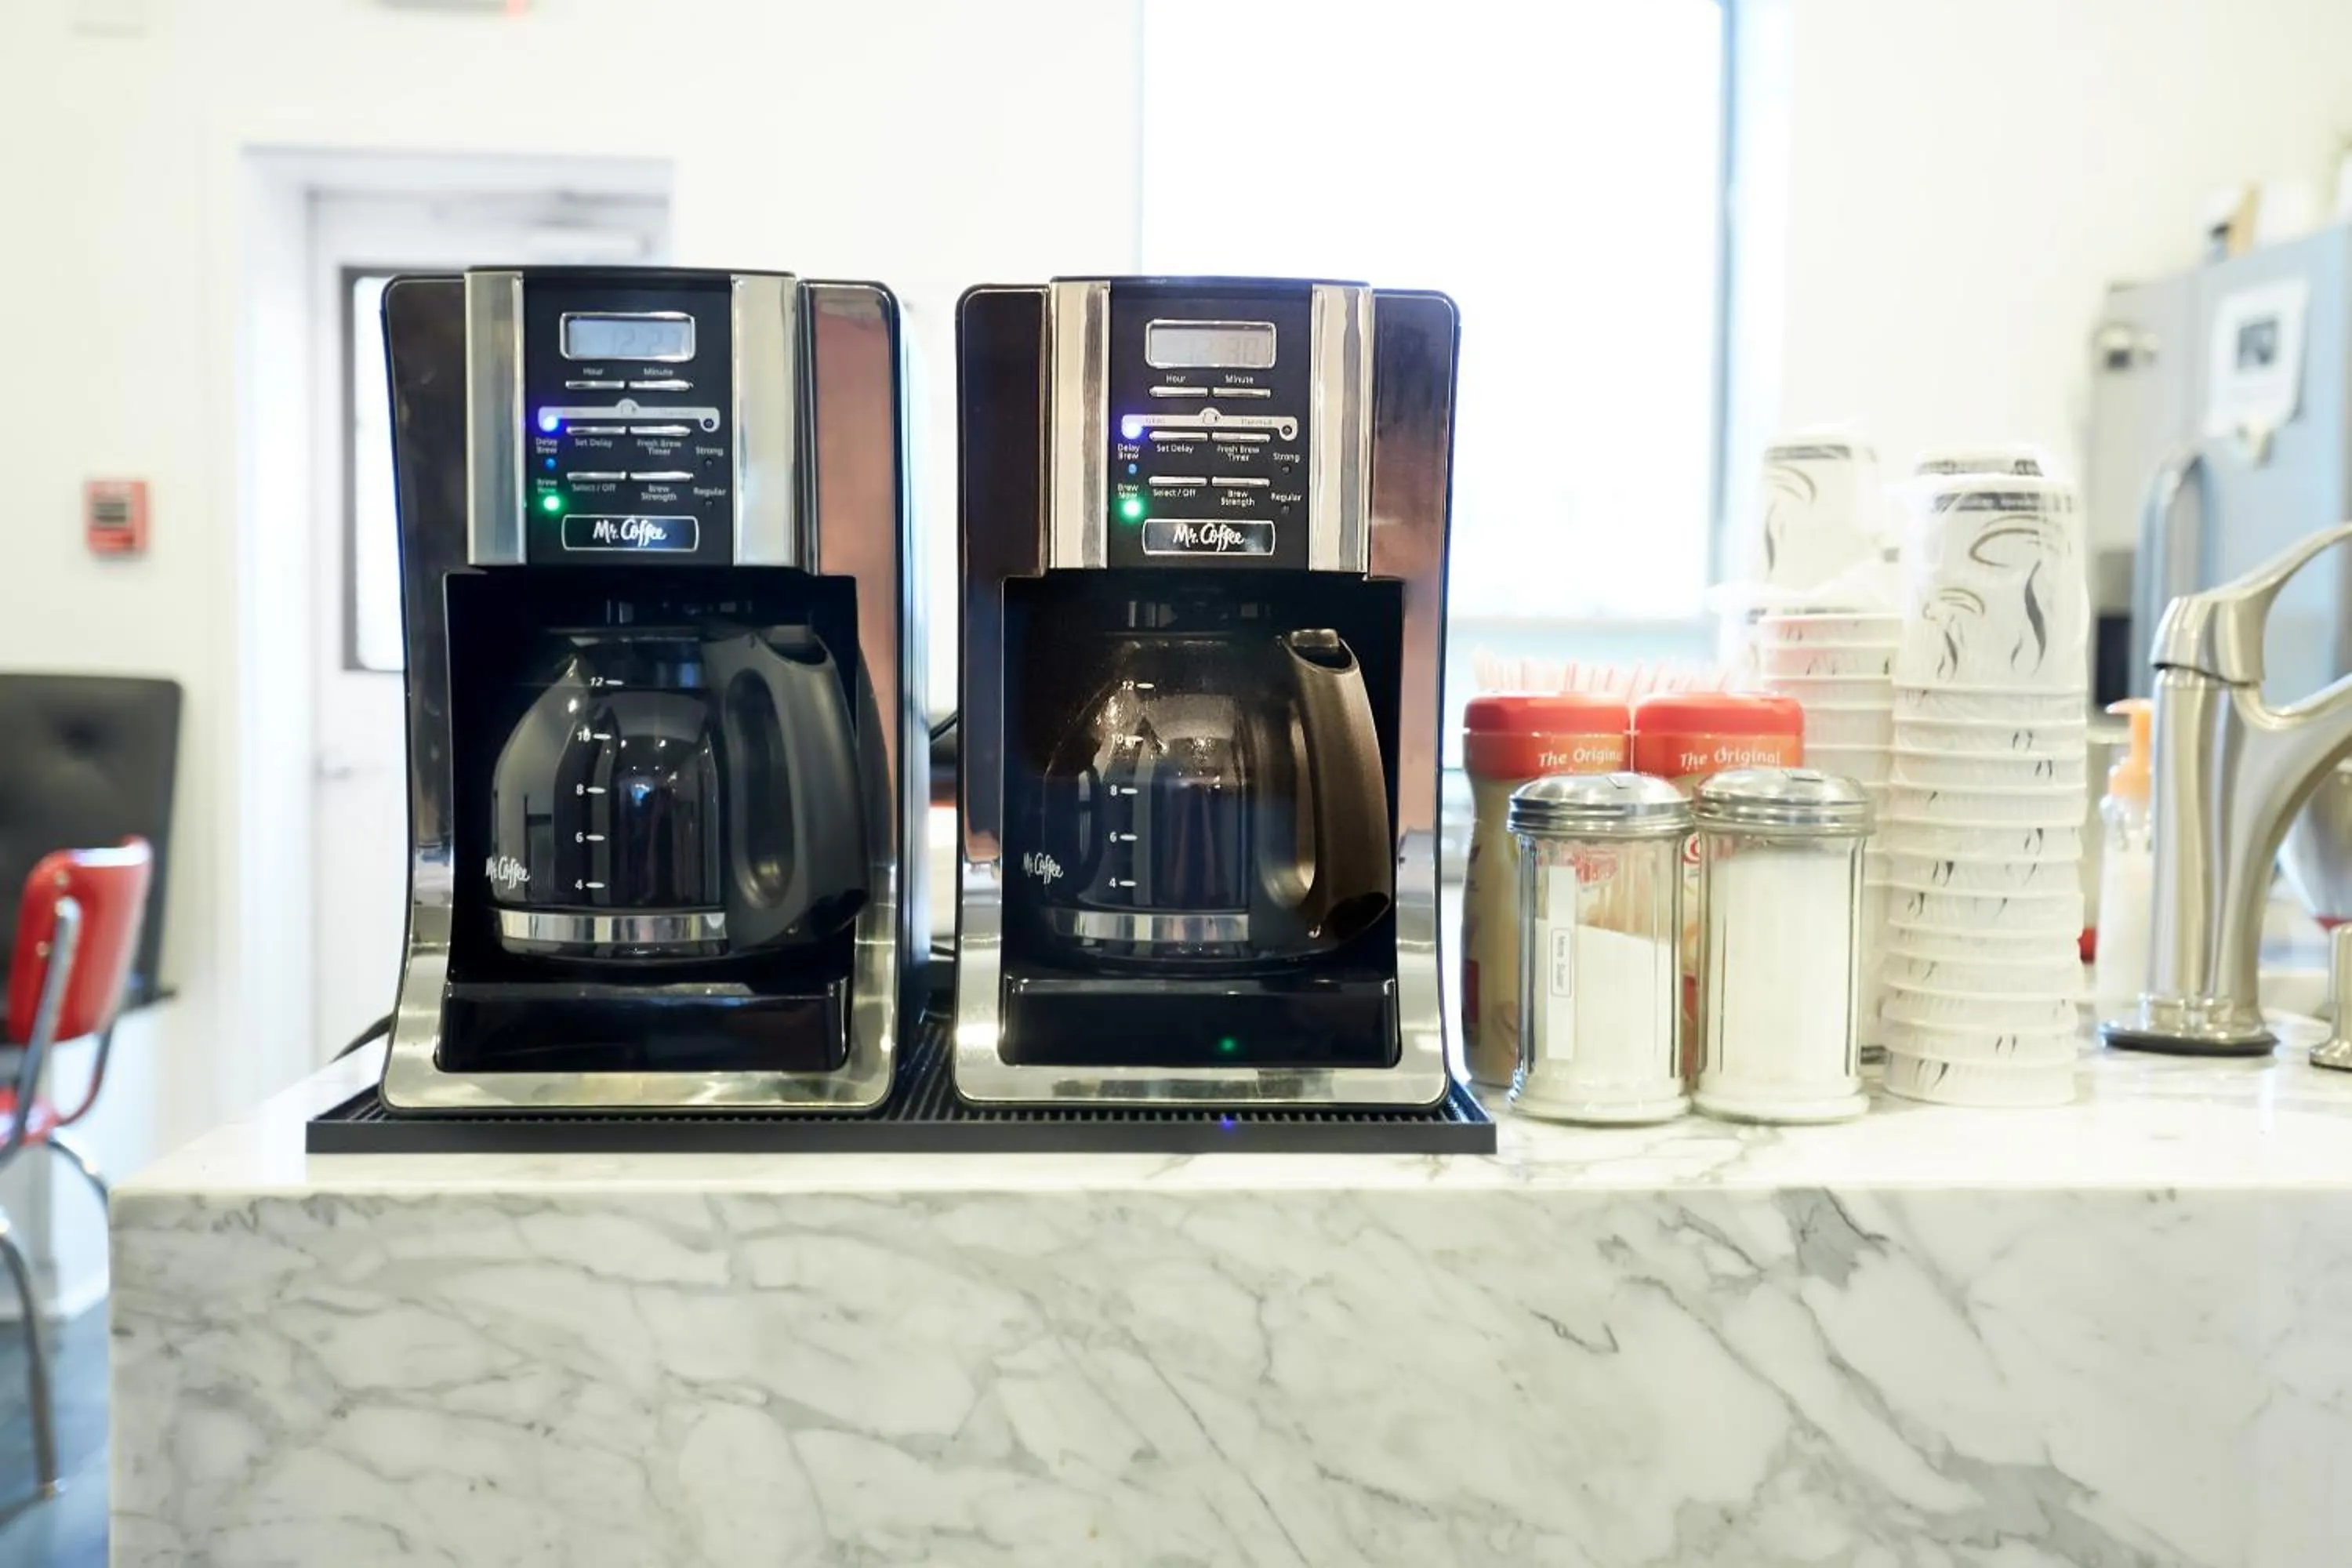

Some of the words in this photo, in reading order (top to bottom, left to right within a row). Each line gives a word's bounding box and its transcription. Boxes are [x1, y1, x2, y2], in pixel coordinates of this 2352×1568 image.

[1225, 375, 1254, 384] Minute
[590, 438, 613, 448] Delay
[637, 439, 658, 448] Fresh
[660, 439, 681, 448] Brew
[1117, 443, 1141, 452] Delay
[695, 445, 724, 456] Strong
[1156, 444, 1170, 452] Set
[1171, 444, 1194, 454] Delay
[1240, 445, 1260, 453] Brew
[1228, 453, 1250, 462] Timer
[1273, 452, 1301, 463] Strong
[572, 483, 596, 492] Select
[602, 483, 616, 492] Off
[693, 487, 727, 498] Regular
[1117, 483, 1139, 492] Brew
[1153, 488, 1176, 497] Select
[1182, 488, 1196, 497] Off
[641, 492, 677, 502] Strength
[1228, 489, 1248, 498] Brew
[1271, 492, 1301, 503] Regular
[1221, 497, 1254, 507] Strength
[593, 519, 619, 543] Mr.
[620, 517, 666, 547] Coffee
[1173, 524, 1199, 548] Mr.
[1200, 523, 1245, 551] Coffee
[590, 677, 604, 687] 12
[1122, 680, 1134, 690] 12
[1538, 751, 1567, 768] The
[1680, 752, 1708, 769] The
[1715, 746, 1780, 765] Original
[576, 784, 584, 796] 8
[1109, 785, 1117, 796] 8
[575, 832, 584, 843] 6
[1109, 832, 1117, 842] 6
[498, 855, 531, 889] Coffee
[1034, 852, 1064, 884] Coffee
[575, 879, 583, 890] 4
[1109, 877, 1116, 887] 4
